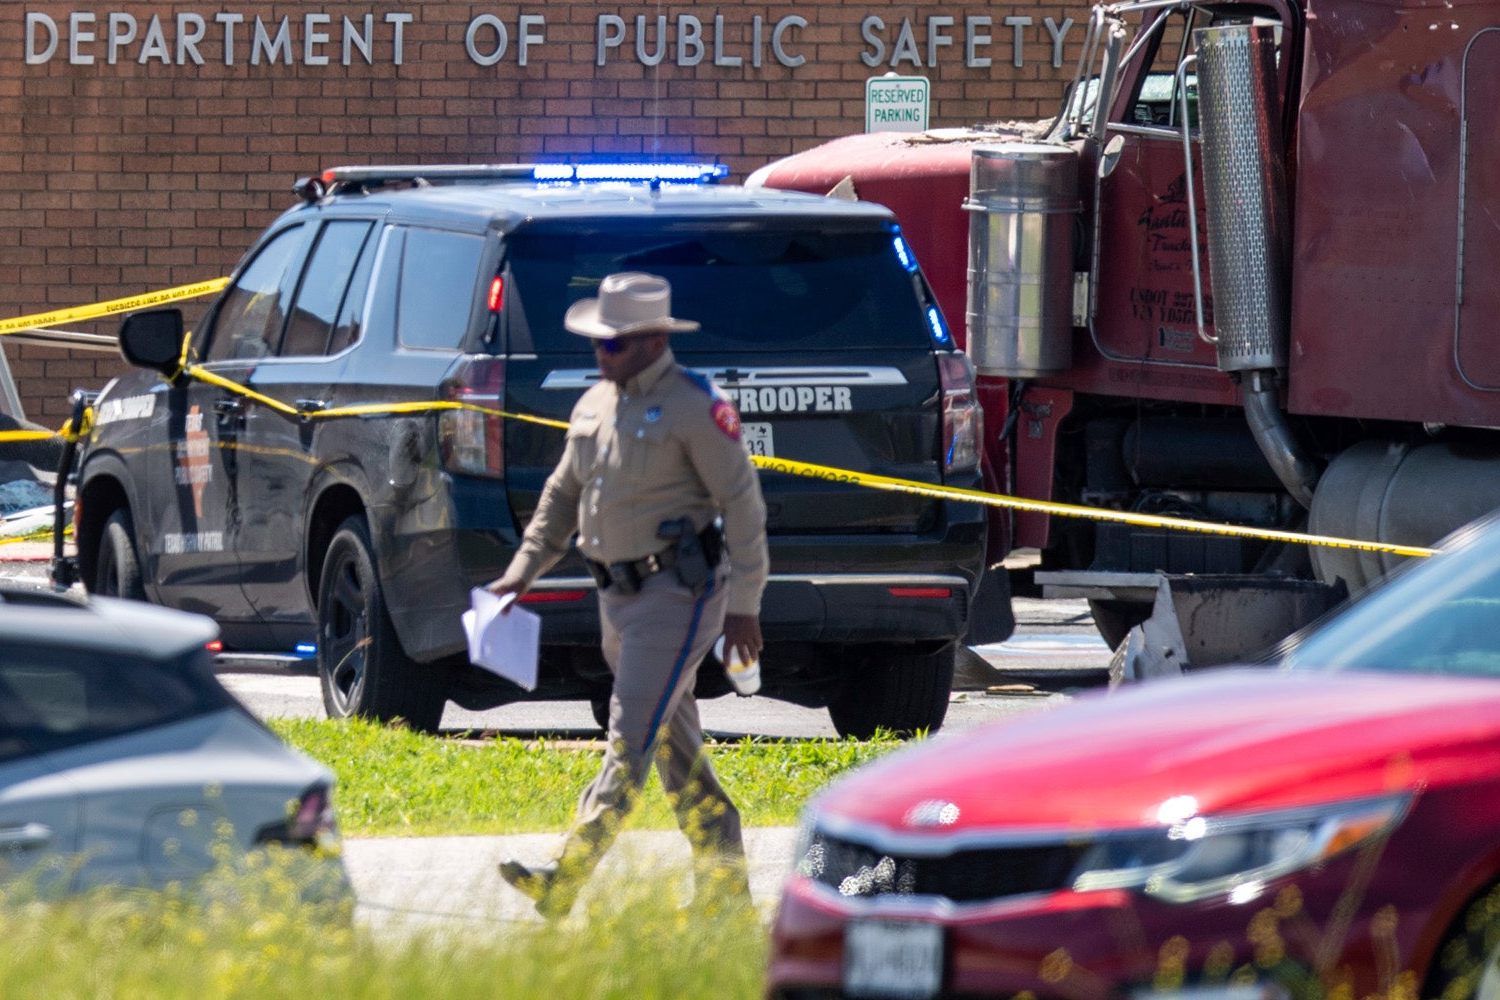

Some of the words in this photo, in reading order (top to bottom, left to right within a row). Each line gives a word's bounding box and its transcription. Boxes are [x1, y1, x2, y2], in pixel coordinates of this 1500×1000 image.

[25, 12, 412, 66] DEPARTMENT
[465, 13, 545, 67] OF
[597, 14, 808, 68] PUBLIC
[860, 15, 1074, 68] SAFETY
[871, 89, 924, 103] RESERVED
[874, 108, 920, 122] PARKING
